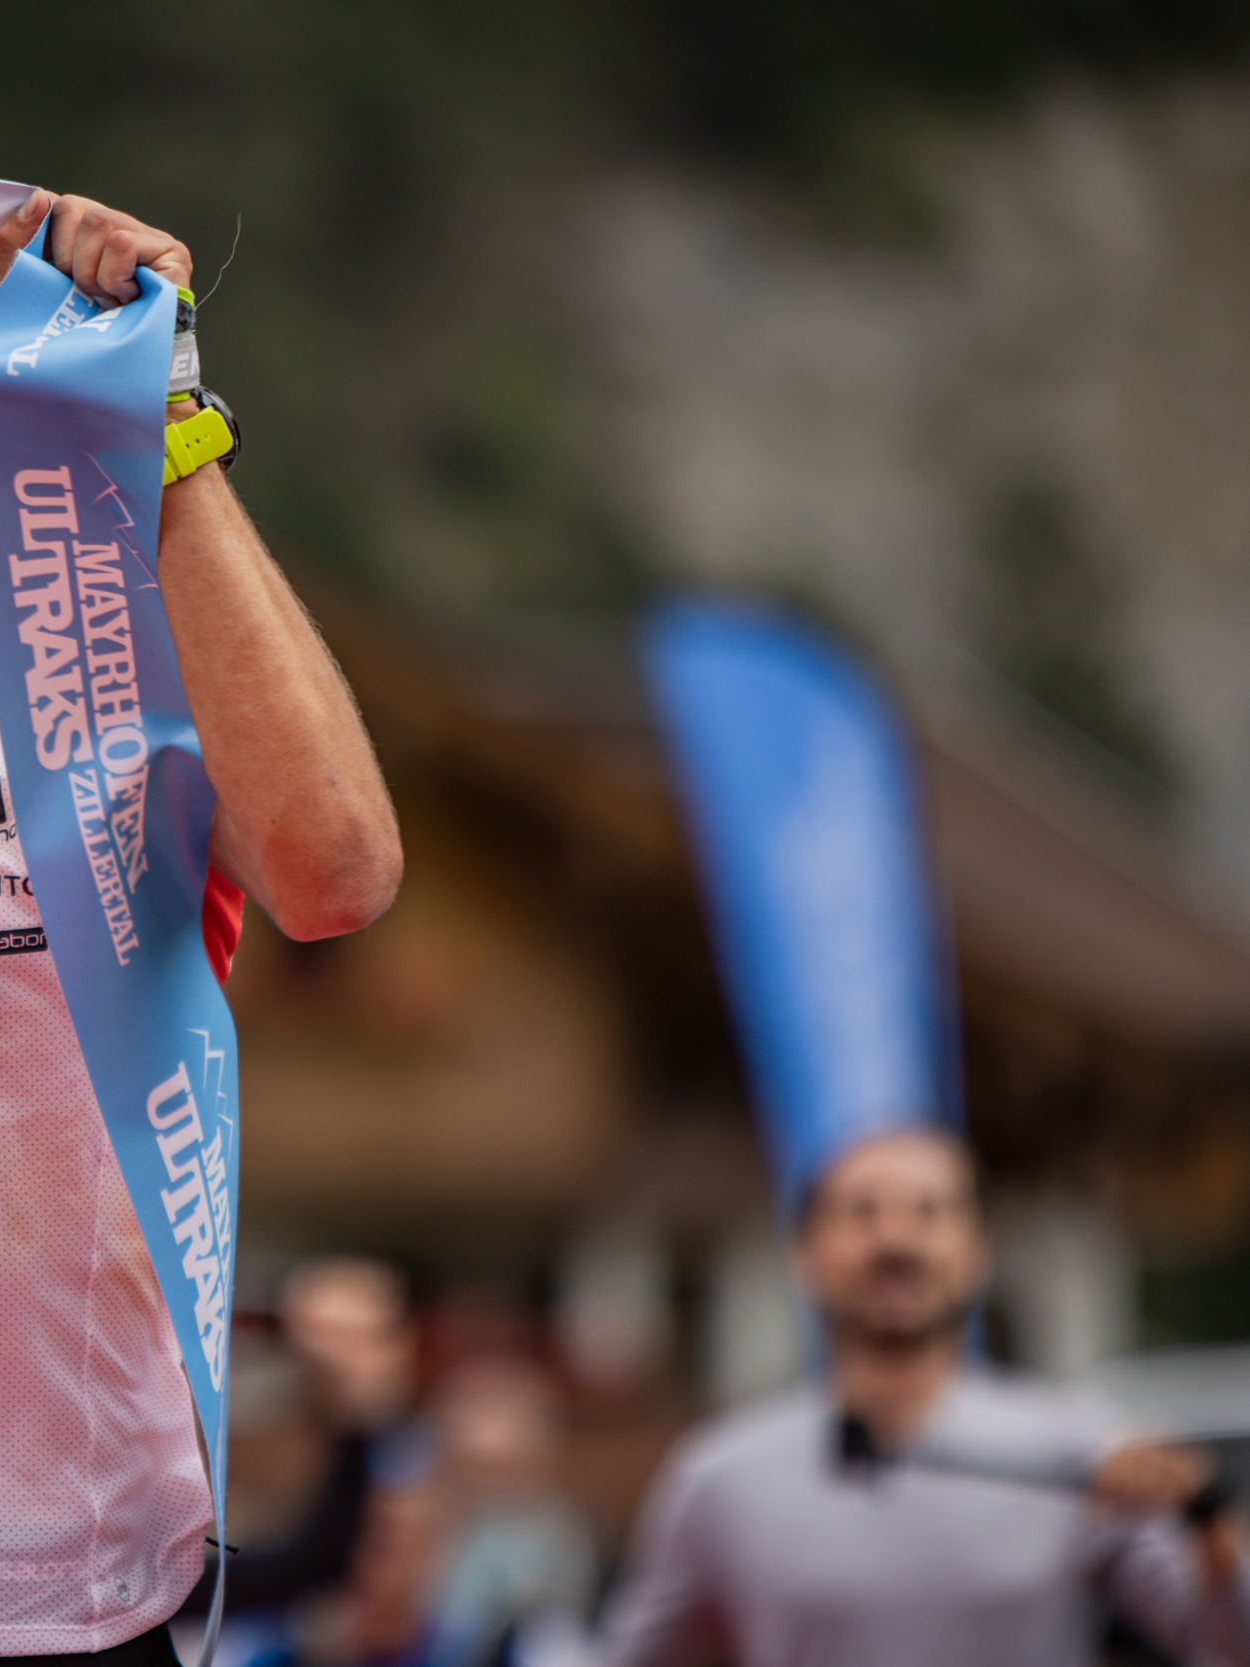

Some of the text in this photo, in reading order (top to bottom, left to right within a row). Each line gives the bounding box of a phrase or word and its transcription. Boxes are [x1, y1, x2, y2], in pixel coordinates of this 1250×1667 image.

[8, 465, 95, 771] ULTRAKS
[68, 768, 140, 967] ZILLERTAL
[72, 540, 149, 895] MAYRHOFEN
[147, 1061, 228, 1394] ULTRAKS
